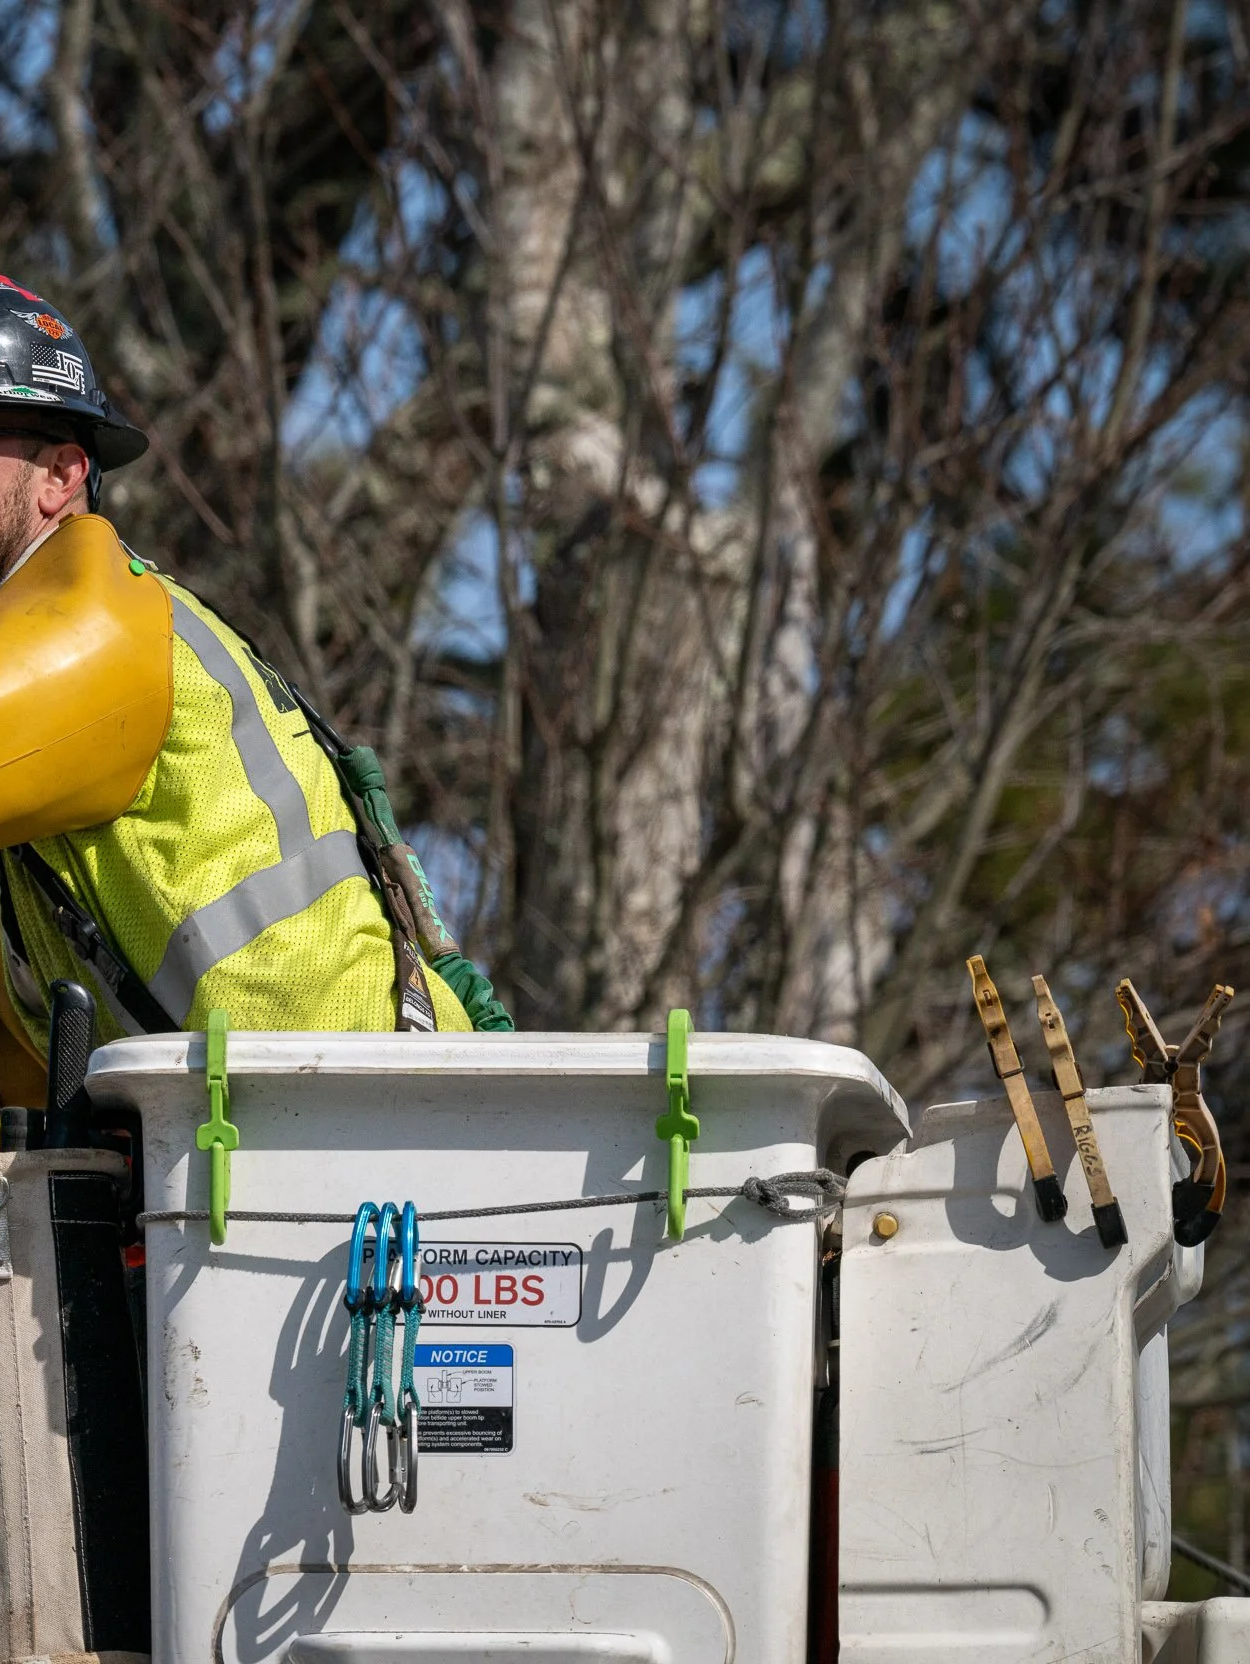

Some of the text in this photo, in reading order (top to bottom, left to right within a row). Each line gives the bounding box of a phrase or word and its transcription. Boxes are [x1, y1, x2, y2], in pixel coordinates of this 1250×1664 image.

[406, 853, 454, 943] BUCK
[475, 1249, 573, 1266] CAPACITY
[474, 1274, 545, 1306] LBS
[428, 1310, 507, 1319] WITHOUT LINER
[430, 1350, 488, 1363] NOTICE
